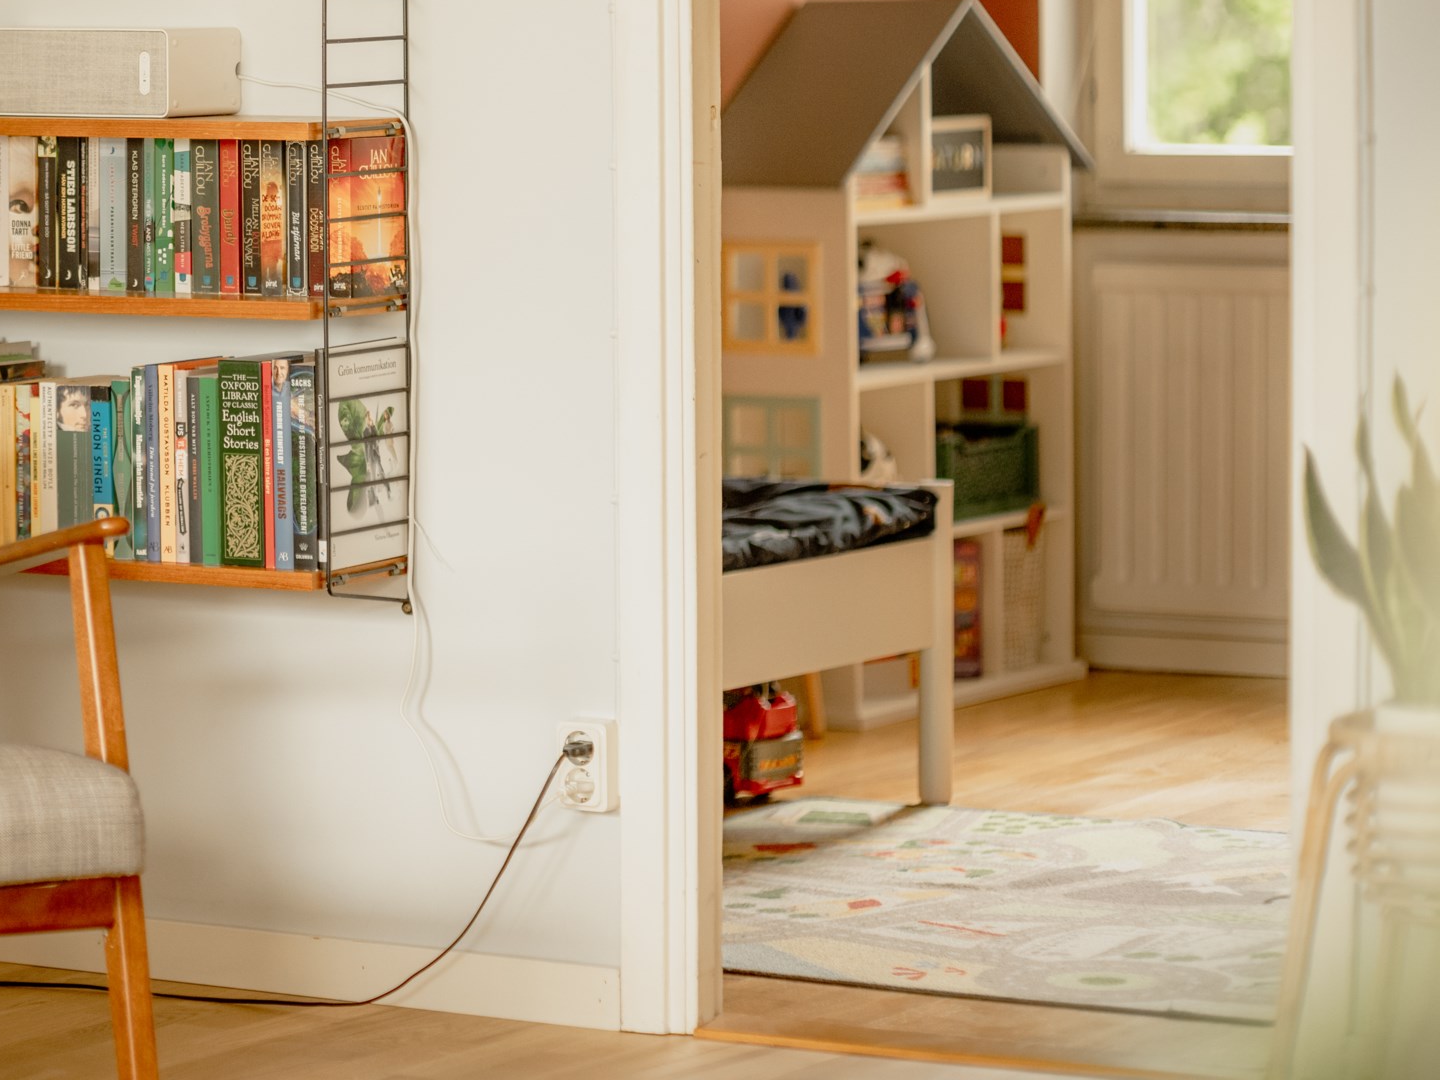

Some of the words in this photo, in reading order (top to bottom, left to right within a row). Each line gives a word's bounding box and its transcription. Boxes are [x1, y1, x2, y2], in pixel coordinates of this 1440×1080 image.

[228, 159, 236, 177] JAN
[243, 144, 253, 189] GUILLOU
[250, 157, 260, 177] JAN
[310, 144, 319, 184] GUILLOU
[370, 148, 388, 165] JAN
[66, 160, 76, 196] STIEG
[195, 145, 208, 195] GUILLOU
[204, 160, 214, 182] JAN
[358, 164, 398, 180] GUILLOU
[12, 220, 31, 228] DONNA
[251, 198, 260, 229] MELLAN
[291, 211, 301, 224] Blå
[66, 198, 76, 253] LARSSON
[197, 206, 214, 268] Brobyggarna
[222, 208, 237, 246] Dandy
[263, 222, 281, 230] SOVER
[243, 238, 253, 268] SVART
[251, 231, 261, 257] RÖTT
[291, 225, 302, 261] stjärnan
[12, 251, 33, 259] FRIEND
[265, 280, 278, 289] pirat
[337, 364, 353, 377] Grön
[354, 358, 397, 374] kommunikation
[221, 381, 259, 391] OXFORD
[291, 379, 311, 387] SACHS
[222, 392, 259, 401] LIBRARY
[222, 409, 259, 426] English
[298, 425, 306, 433] OF
[92, 411, 101, 450] SIMON
[176, 423, 184, 436] US
[227, 424, 255, 436] Short
[135, 434, 143, 459] Mannen
[223, 437, 259, 449] Stories
[276, 430, 284, 465] REINFELDT
[93, 455, 102, 494] SINGH
[177, 452, 185, 477] THEM
[135, 475, 144, 508] framtiden
[148, 482, 156, 493] på
[277, 468, 288, 520] HALVVÄGS
[148, 493, 156, 518] jorden
[300, 484, 308, 535] DEVELOPMENT
